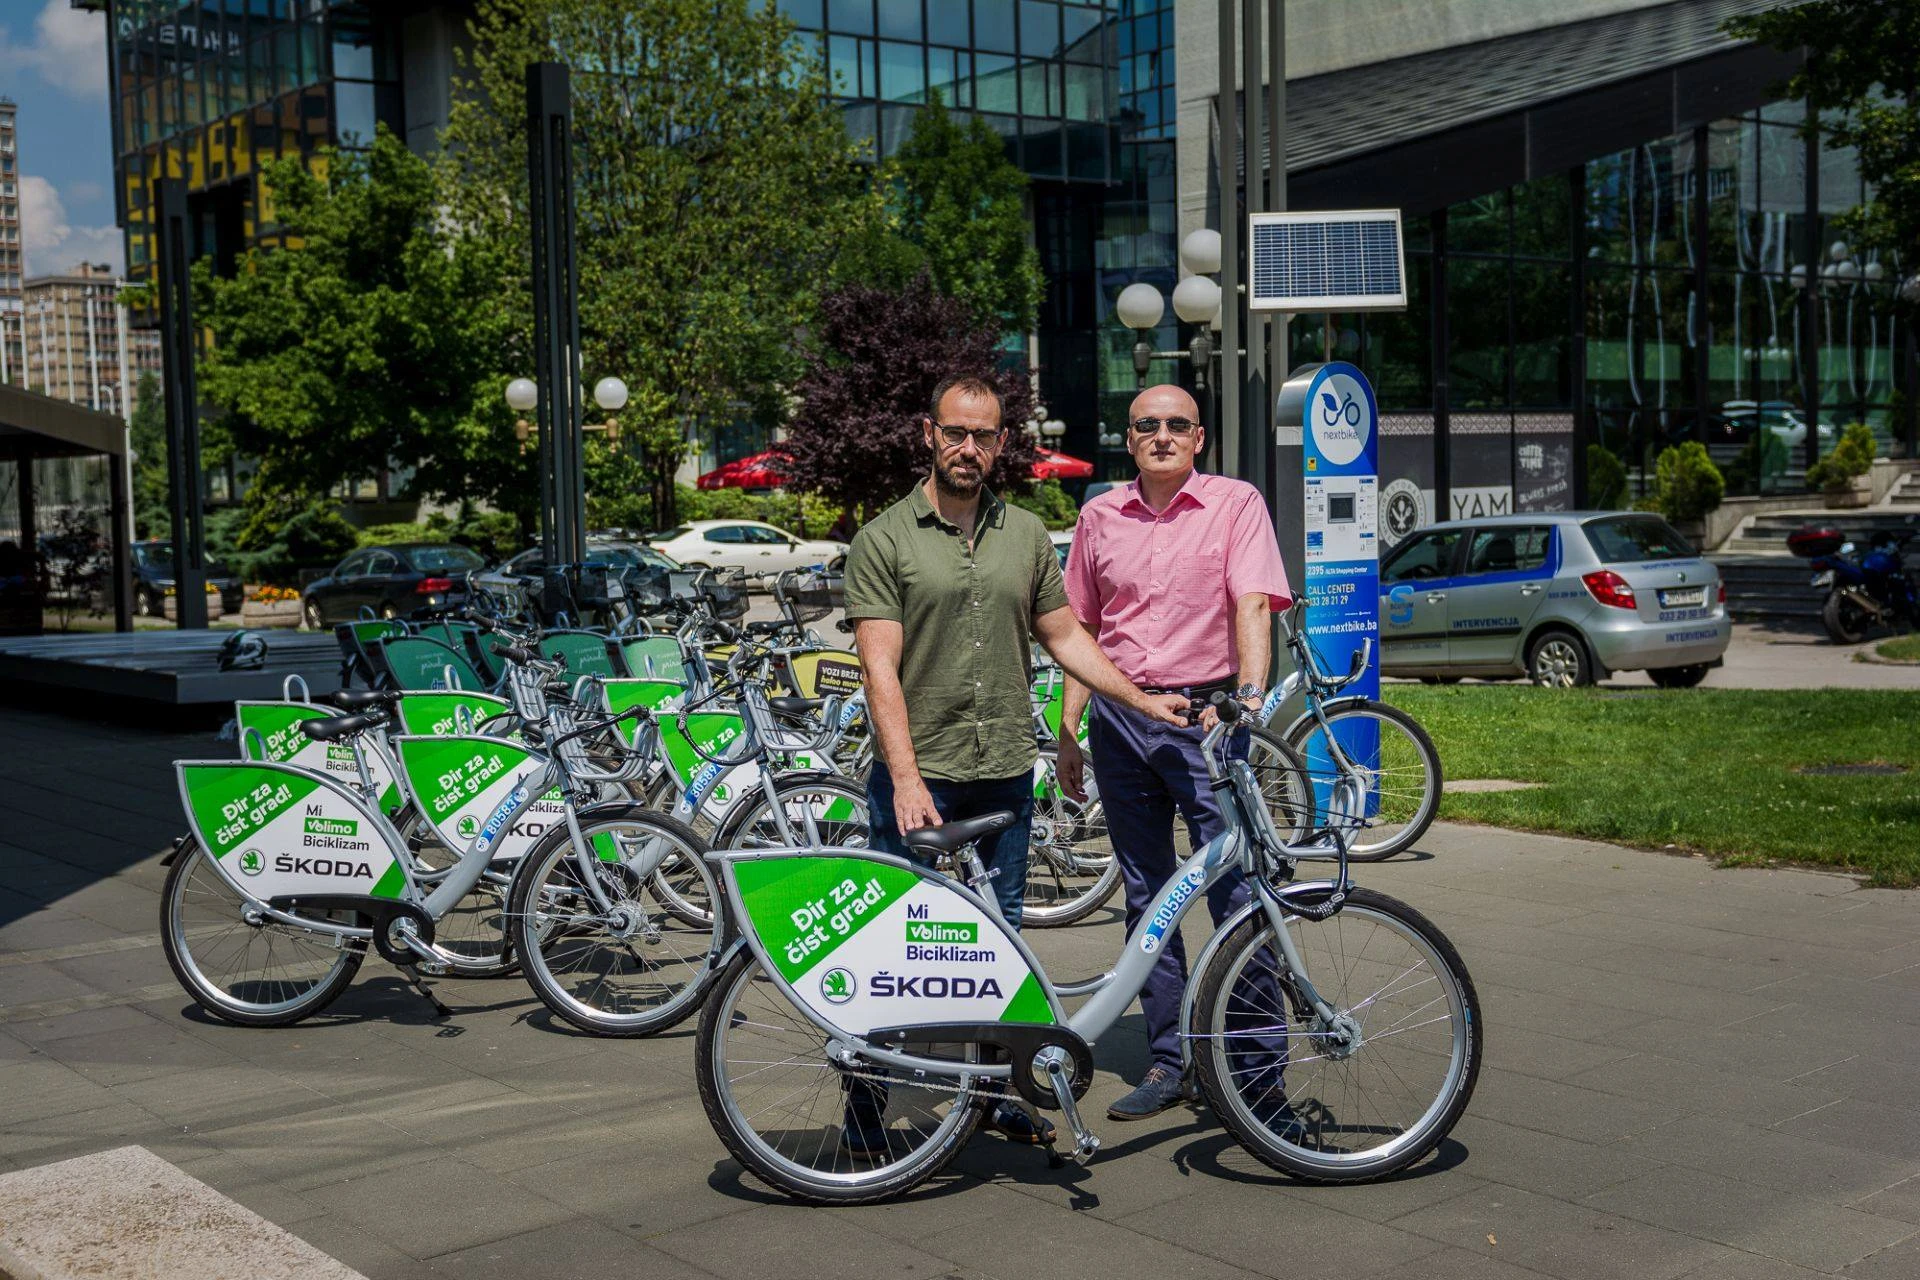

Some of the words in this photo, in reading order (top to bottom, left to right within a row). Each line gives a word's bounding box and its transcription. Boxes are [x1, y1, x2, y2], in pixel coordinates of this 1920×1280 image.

[1323, 429, 1359, 440] nextbike
[1307, 565, 1324, 576] 2395
[1307, 585, 1326, 595] CALL
[1327, 583, 1356, 594] CENTER
[1321, 596, 1330, 606] 28
[1331, 596, 1339, 605] 21
[1340, 595, 1349, 605] 29
[1453, 617, 1519, 629] INTERVENCIJA
[1659, 611, 1675, 621] 033
[1307, 619, 1378, 635] www.nextbike.ba
[1665, 629, 1718, 643] INTERVENCIJA
[822, 666, 840, 677] VOZI
[840, 669, 859, 680] BRŽE
[266, 730, 287, 750] Đir
[717, 726, 736, 745] za
[268, 745, 287, 763] ist
[325, 761, 375, 774] Biciklizm
[438, 766, 464, 791] Đir
[464, 754, 485, 773] za
[432, 784, 465, 813] čist
[464, 754, 505, 794] grad!
[690, 764, 717, 798] 80589
[222, 795, 250, 822] Đir
[250, 782, 273, 802] za
[306, 804, 322, 817] Mi
[215, 815, 250, 846] čist
[249, 783, 293, 826] grad!
[487, 797, 518, 835] 80583
[303, 835, 370, 851] Biciklizam
[275, 852, 374, 879] ŠKODA
[790, 897, 828, 933] Đir
[828, 877, 859, 902] za
[907, 904, 929, 920] Mi
[1153, 881, 1193, 929] 80588
[783, 924, 831, 965] čist
[830, 877, 887, 936] grad!
[906, 945, 996, 963] Biciklizam
[870, 970, 1004, 1000] ŠKODA
